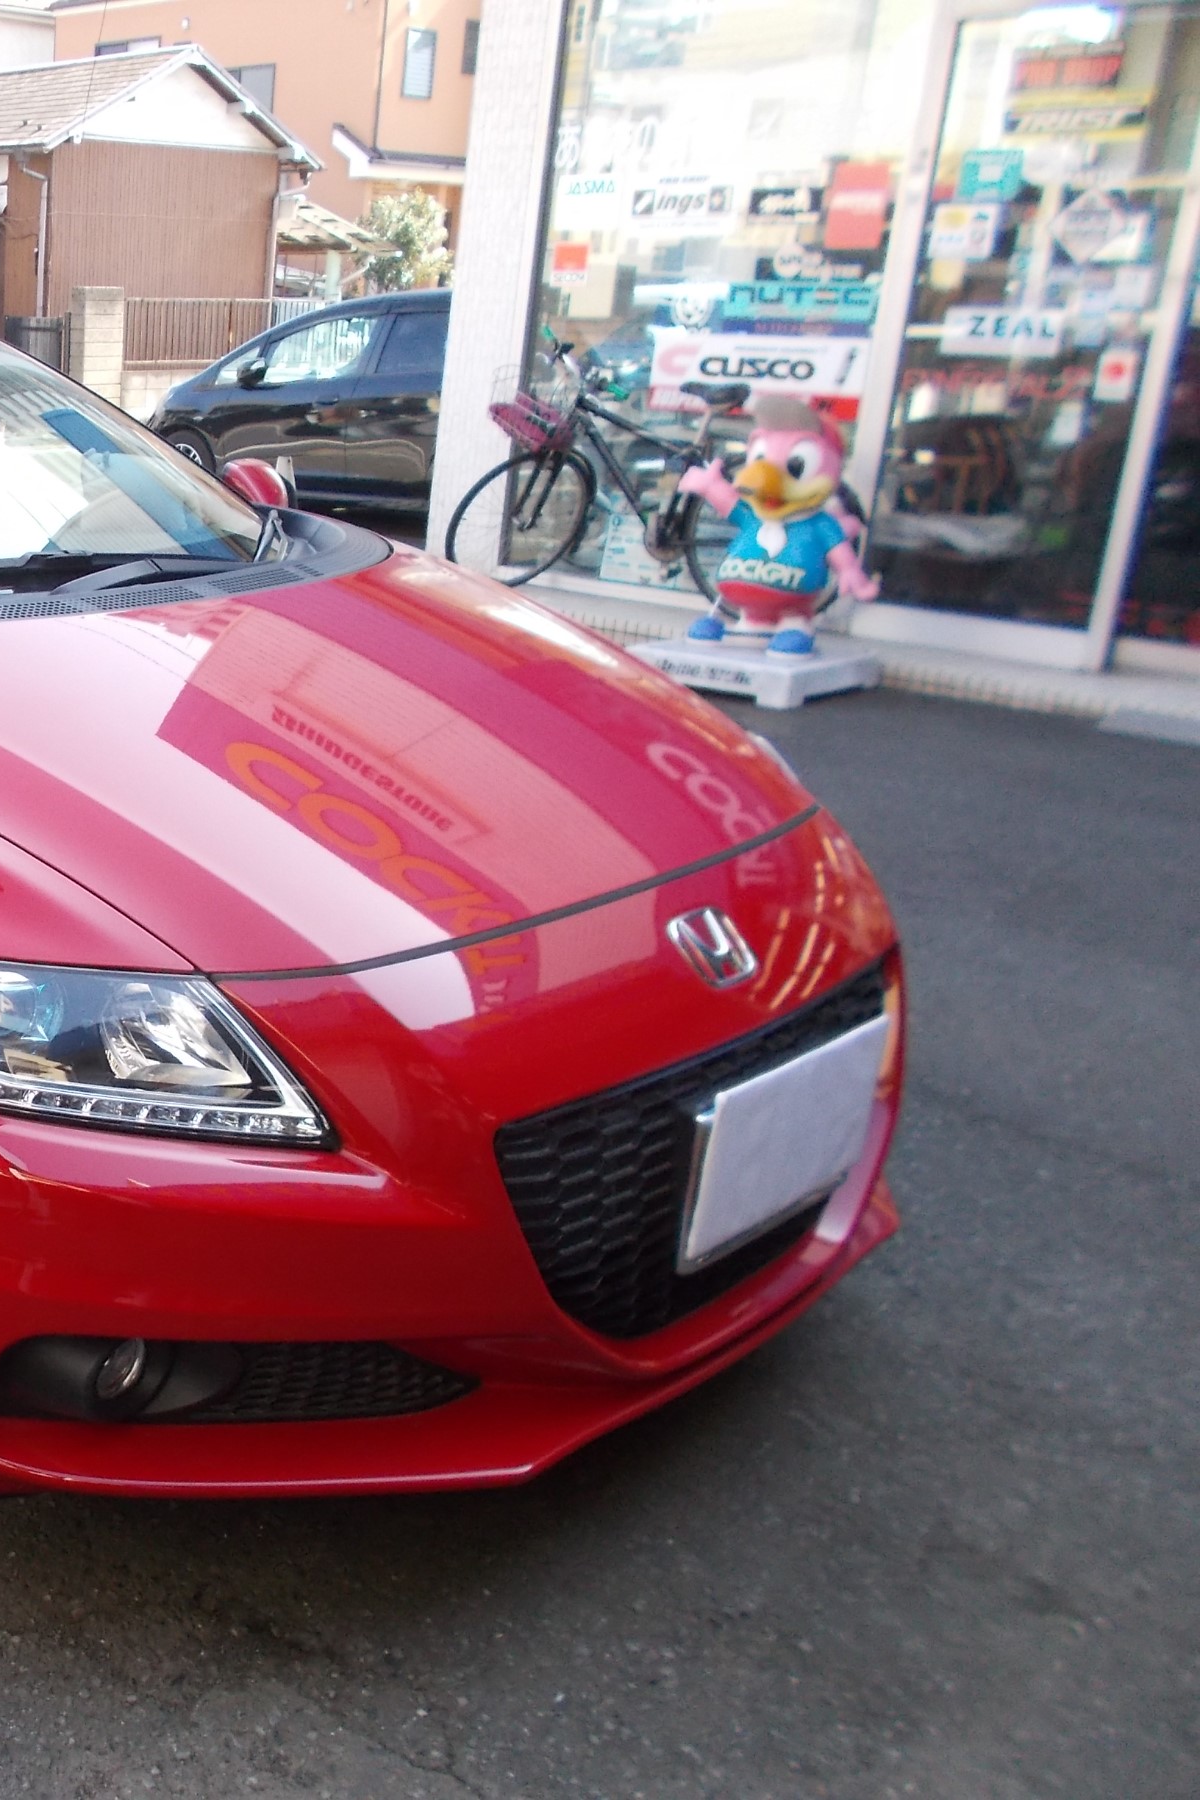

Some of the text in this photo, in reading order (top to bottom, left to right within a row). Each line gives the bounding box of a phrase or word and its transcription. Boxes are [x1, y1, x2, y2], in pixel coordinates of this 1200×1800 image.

[566, 180, 616, 196] JASMA
[968, 315, 1056, 338] ZEAL
[700, 355, 816, 381] CUSCO
[719, 557, 806, 589] COCKPIT
